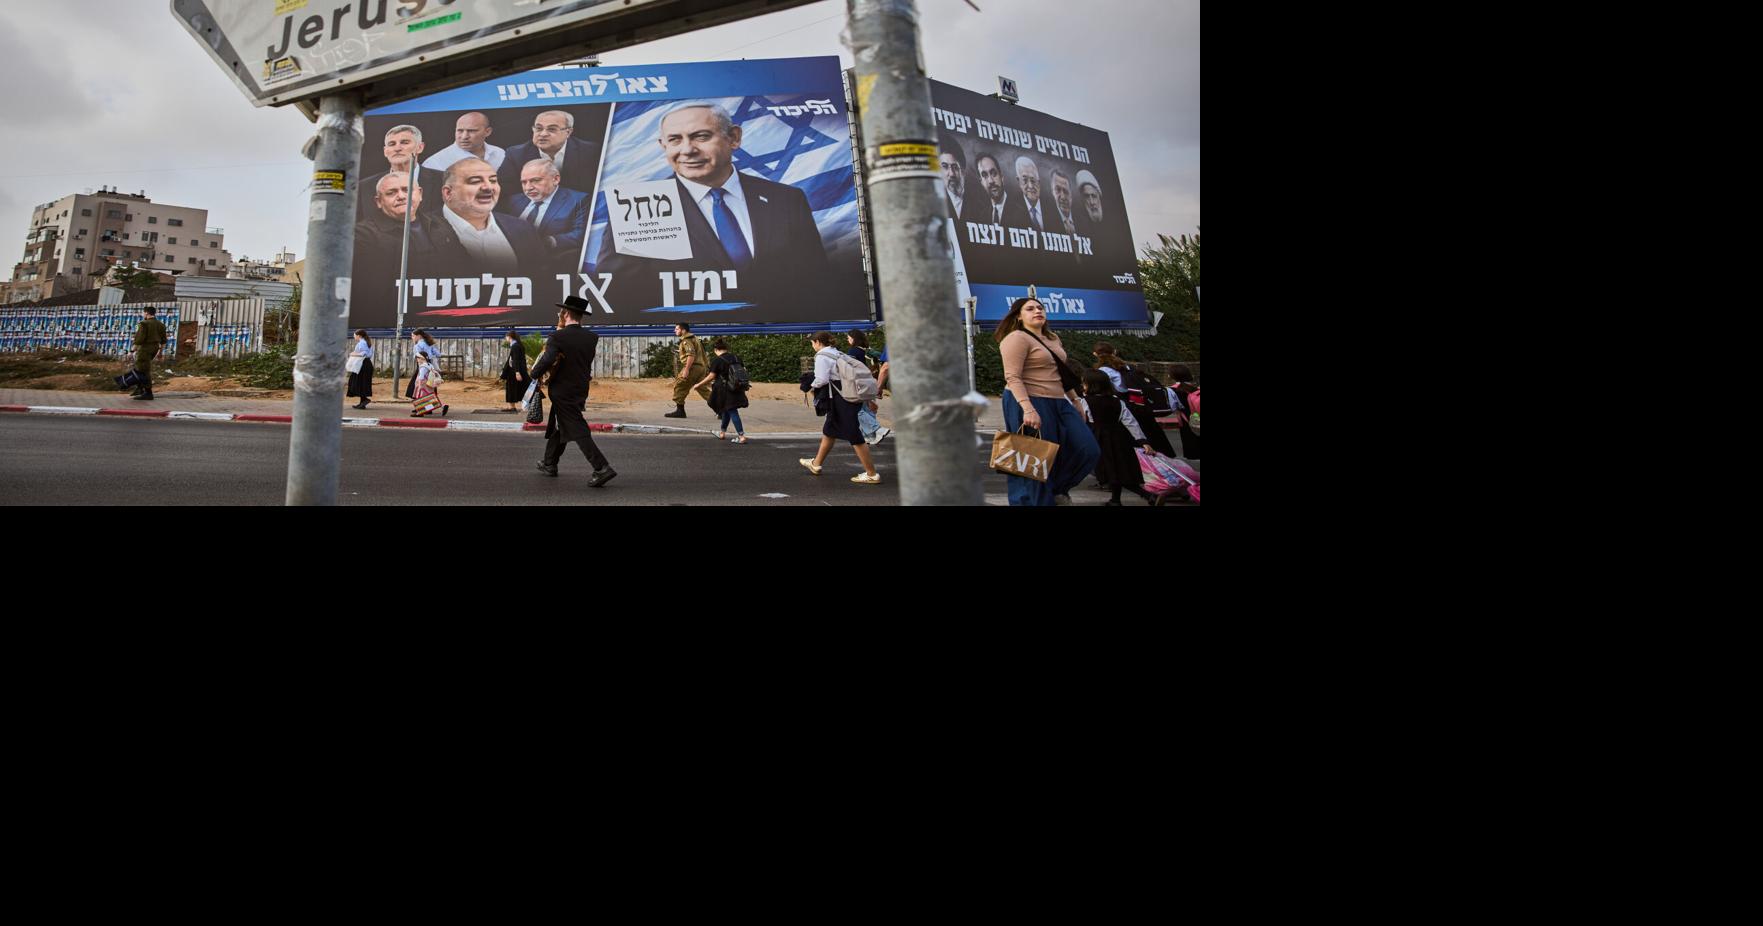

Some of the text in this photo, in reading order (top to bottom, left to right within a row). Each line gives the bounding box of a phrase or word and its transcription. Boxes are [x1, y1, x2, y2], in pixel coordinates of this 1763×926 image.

[497, 72, 669, 101] צאו להצביע!
[766, 98, 838, 117] הליכוד
[975, 118, 1033, 149] שנתניהו
[1035, 134, 1072, 160] רוצים
[1072, 144, 1091, 164] הם
[613, 189, 672, 221] מחל
[966, 221, 1093, 255] אל תתנו להם לנצח
[395, 270, 737, 314] ימין או פלסטין
[1062, 298, 1086, 313] צאו
